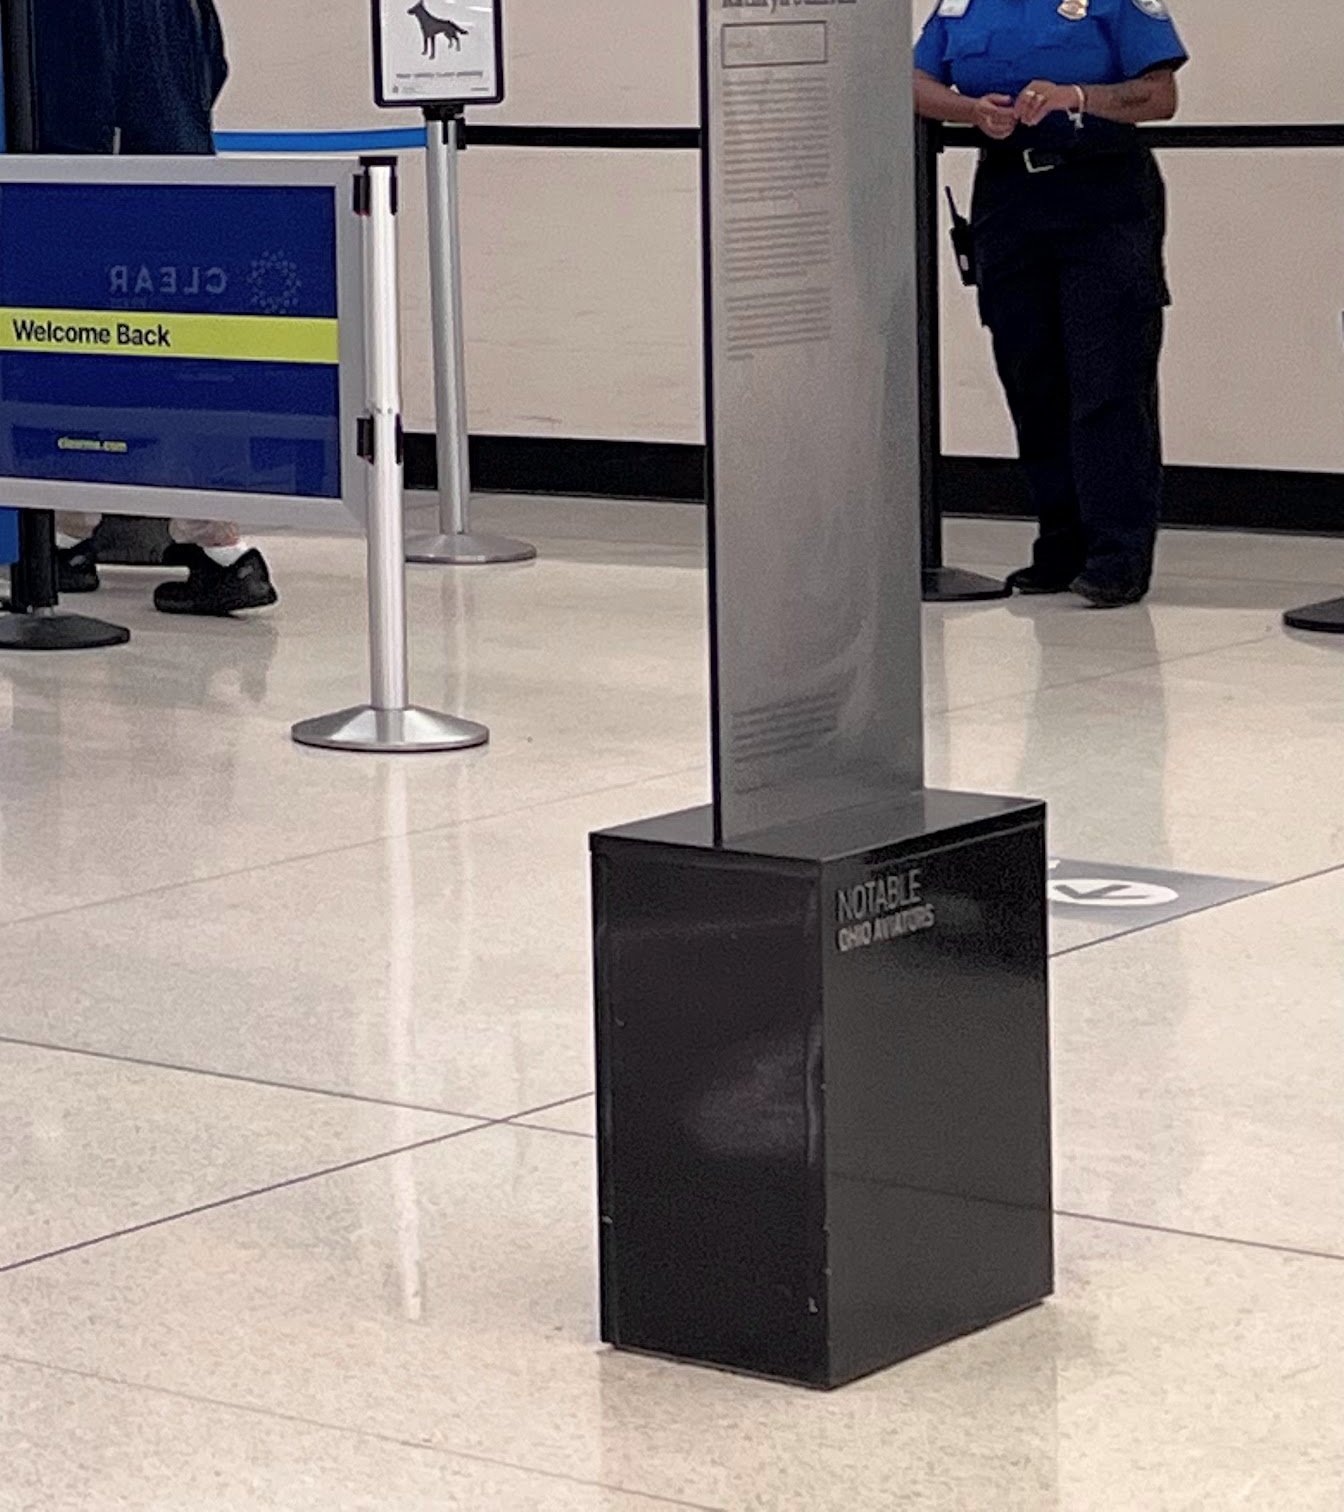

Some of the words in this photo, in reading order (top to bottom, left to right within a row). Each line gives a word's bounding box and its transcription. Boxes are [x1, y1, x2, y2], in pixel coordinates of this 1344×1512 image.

[12, 318, 111, 345] Welcome
[116, 324, 171, 348] Back
[836, 868, 922, 924] NOTABLE
